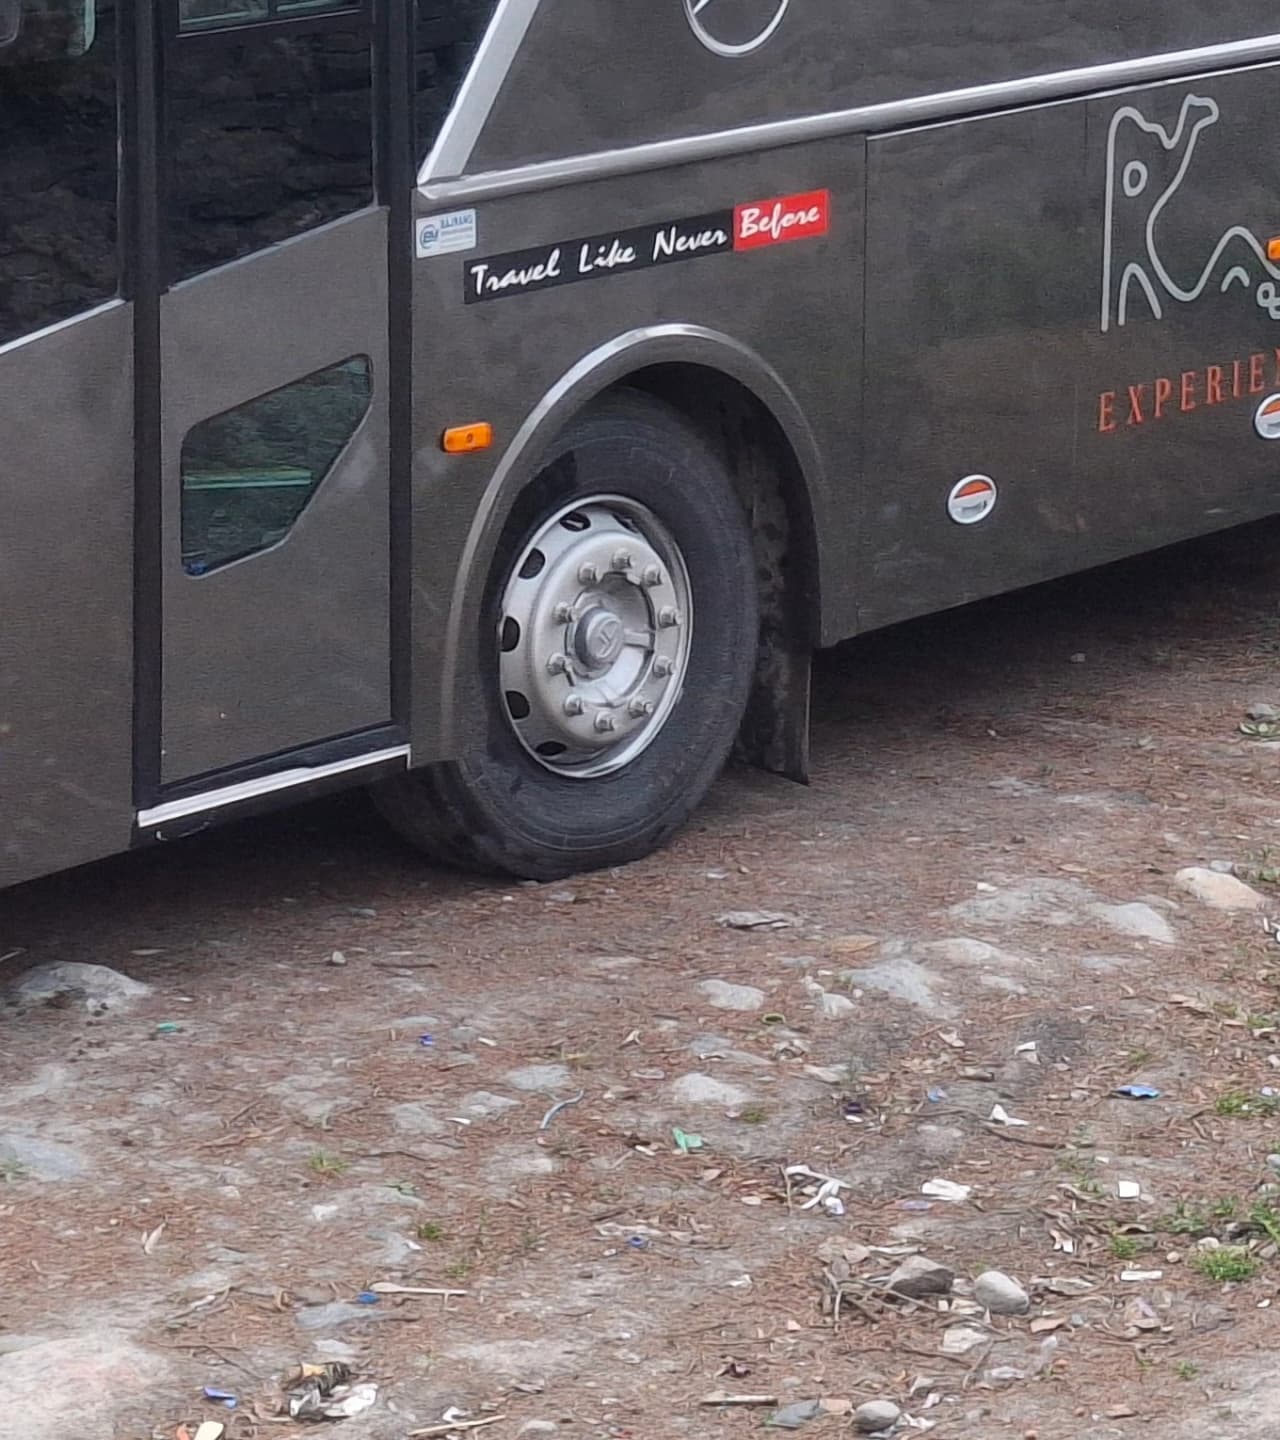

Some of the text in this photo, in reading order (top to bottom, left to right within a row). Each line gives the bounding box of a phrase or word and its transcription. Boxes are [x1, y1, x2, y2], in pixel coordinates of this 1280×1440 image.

[470, 202, 821, 295] Travel Like Never Before
